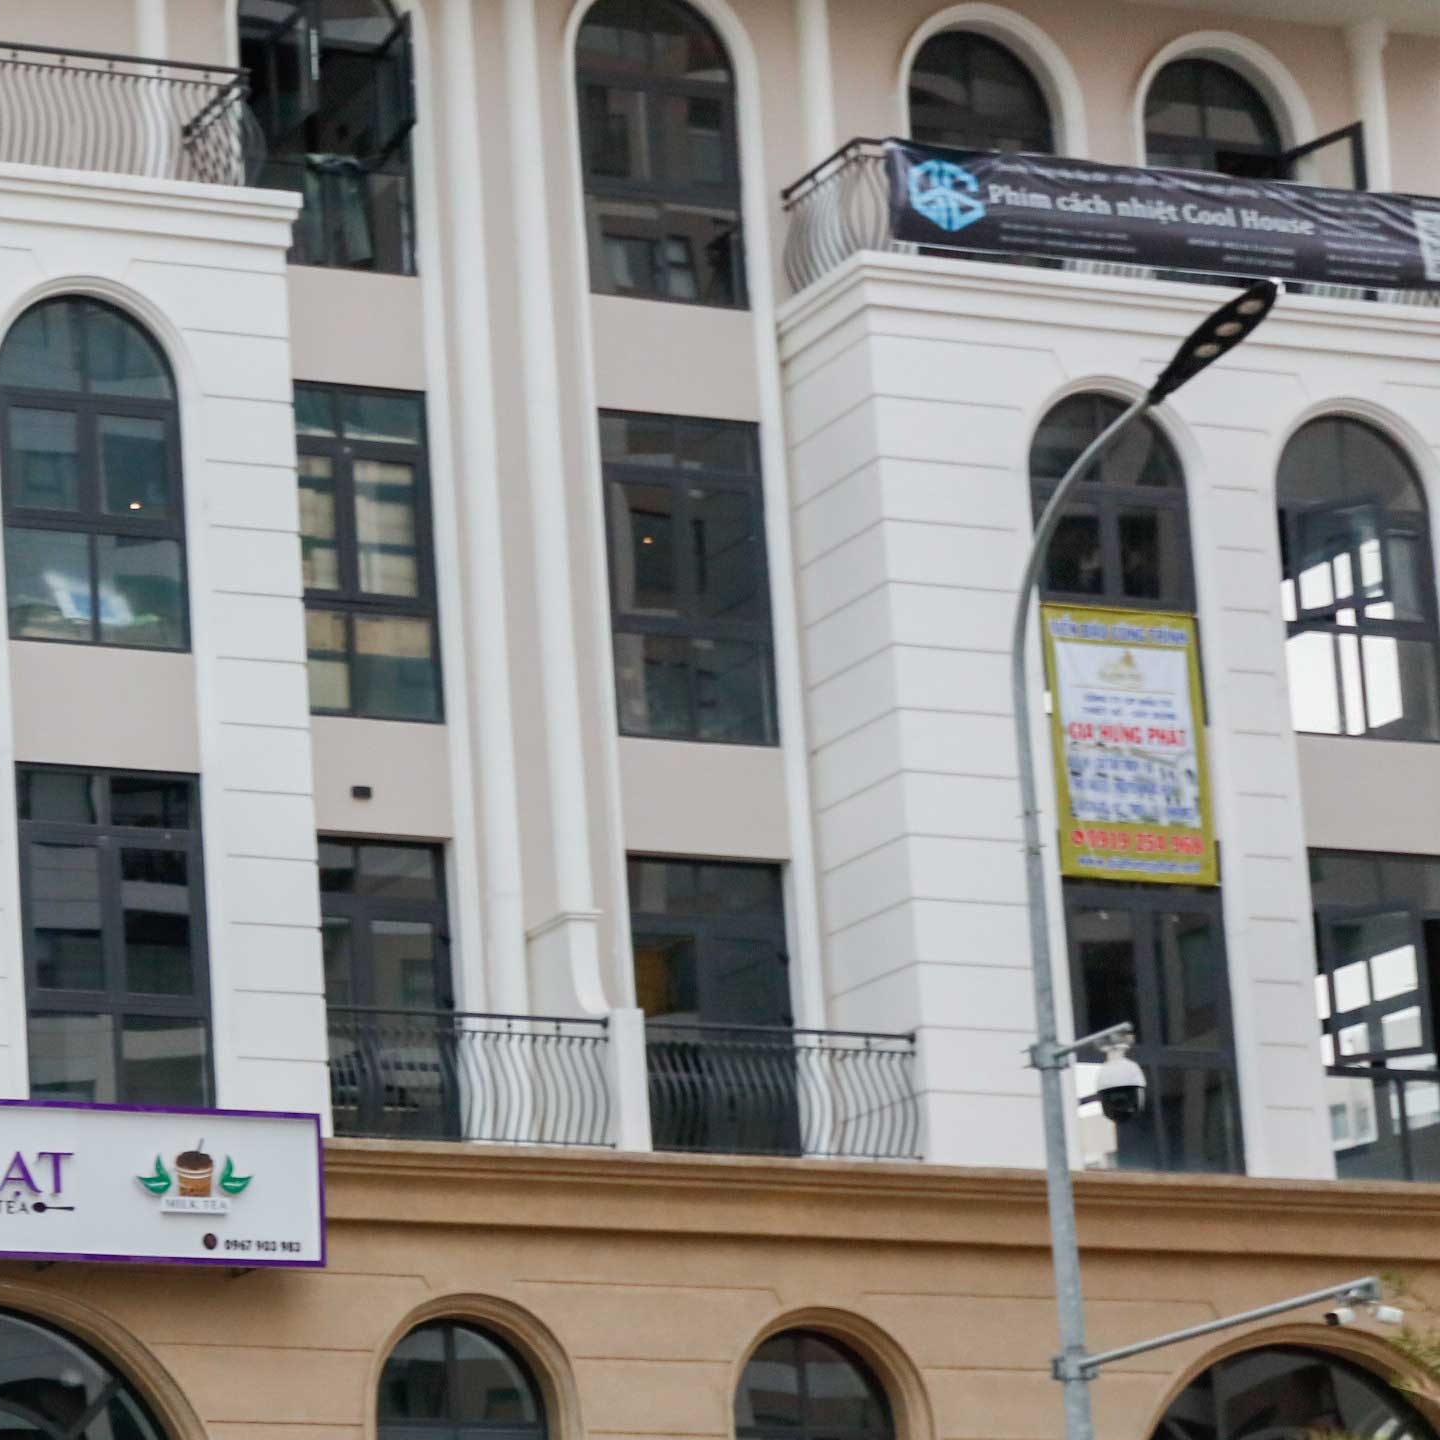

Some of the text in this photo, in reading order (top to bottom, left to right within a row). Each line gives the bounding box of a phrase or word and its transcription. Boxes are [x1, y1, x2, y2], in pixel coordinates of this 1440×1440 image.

[988, 183, 1316, 236] Phim cách nhiệt Cool House
[165, 1199, 228, 1210] MILK TEA
